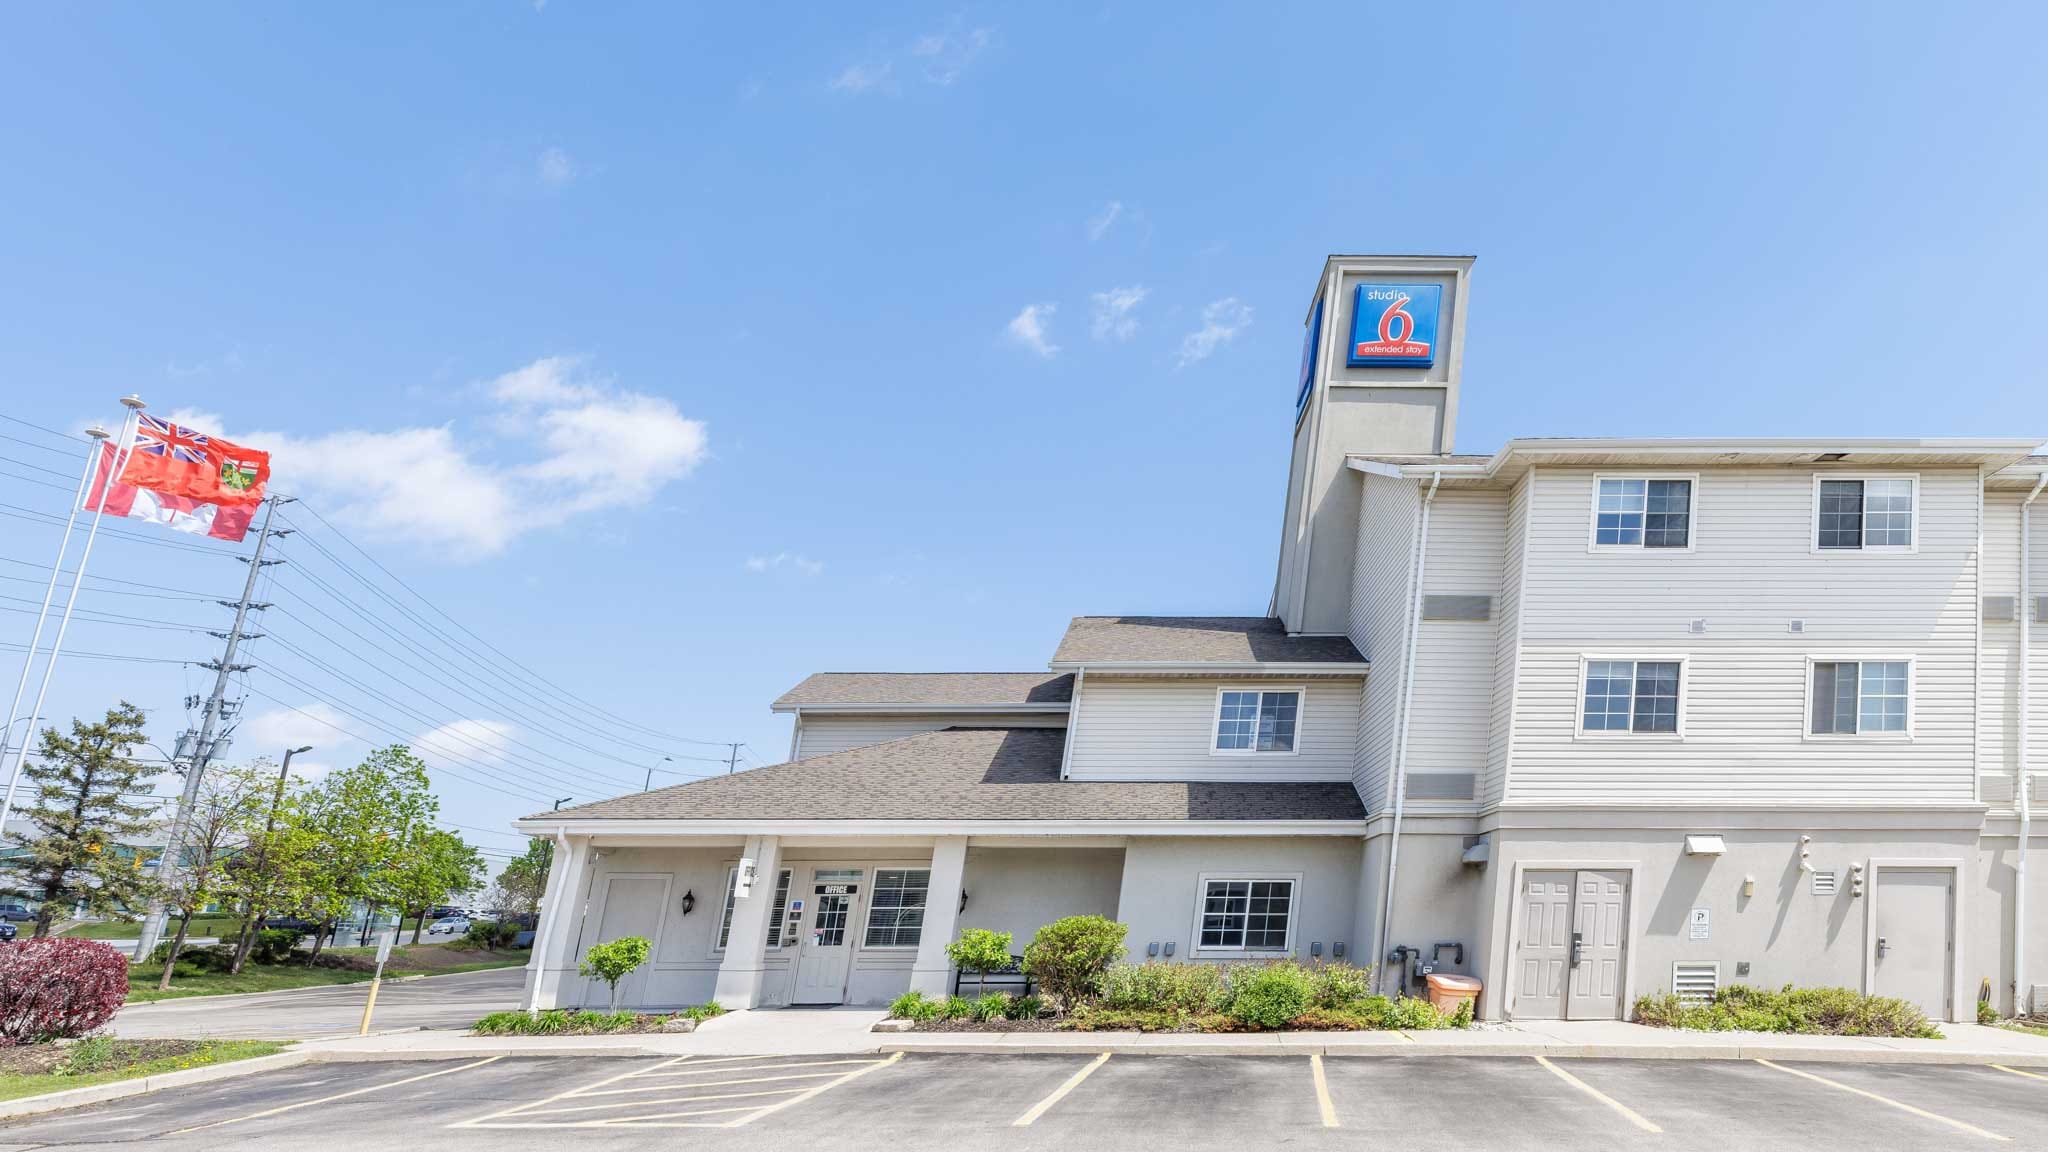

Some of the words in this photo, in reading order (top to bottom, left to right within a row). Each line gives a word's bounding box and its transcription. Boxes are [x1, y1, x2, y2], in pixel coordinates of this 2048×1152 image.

[1368, 289, 1406, 300] studio
[1378, 297, 1414, 342] 6
[1405, 346, 1423, 355] stay
[825, 885, 847, 894] OFFICE
